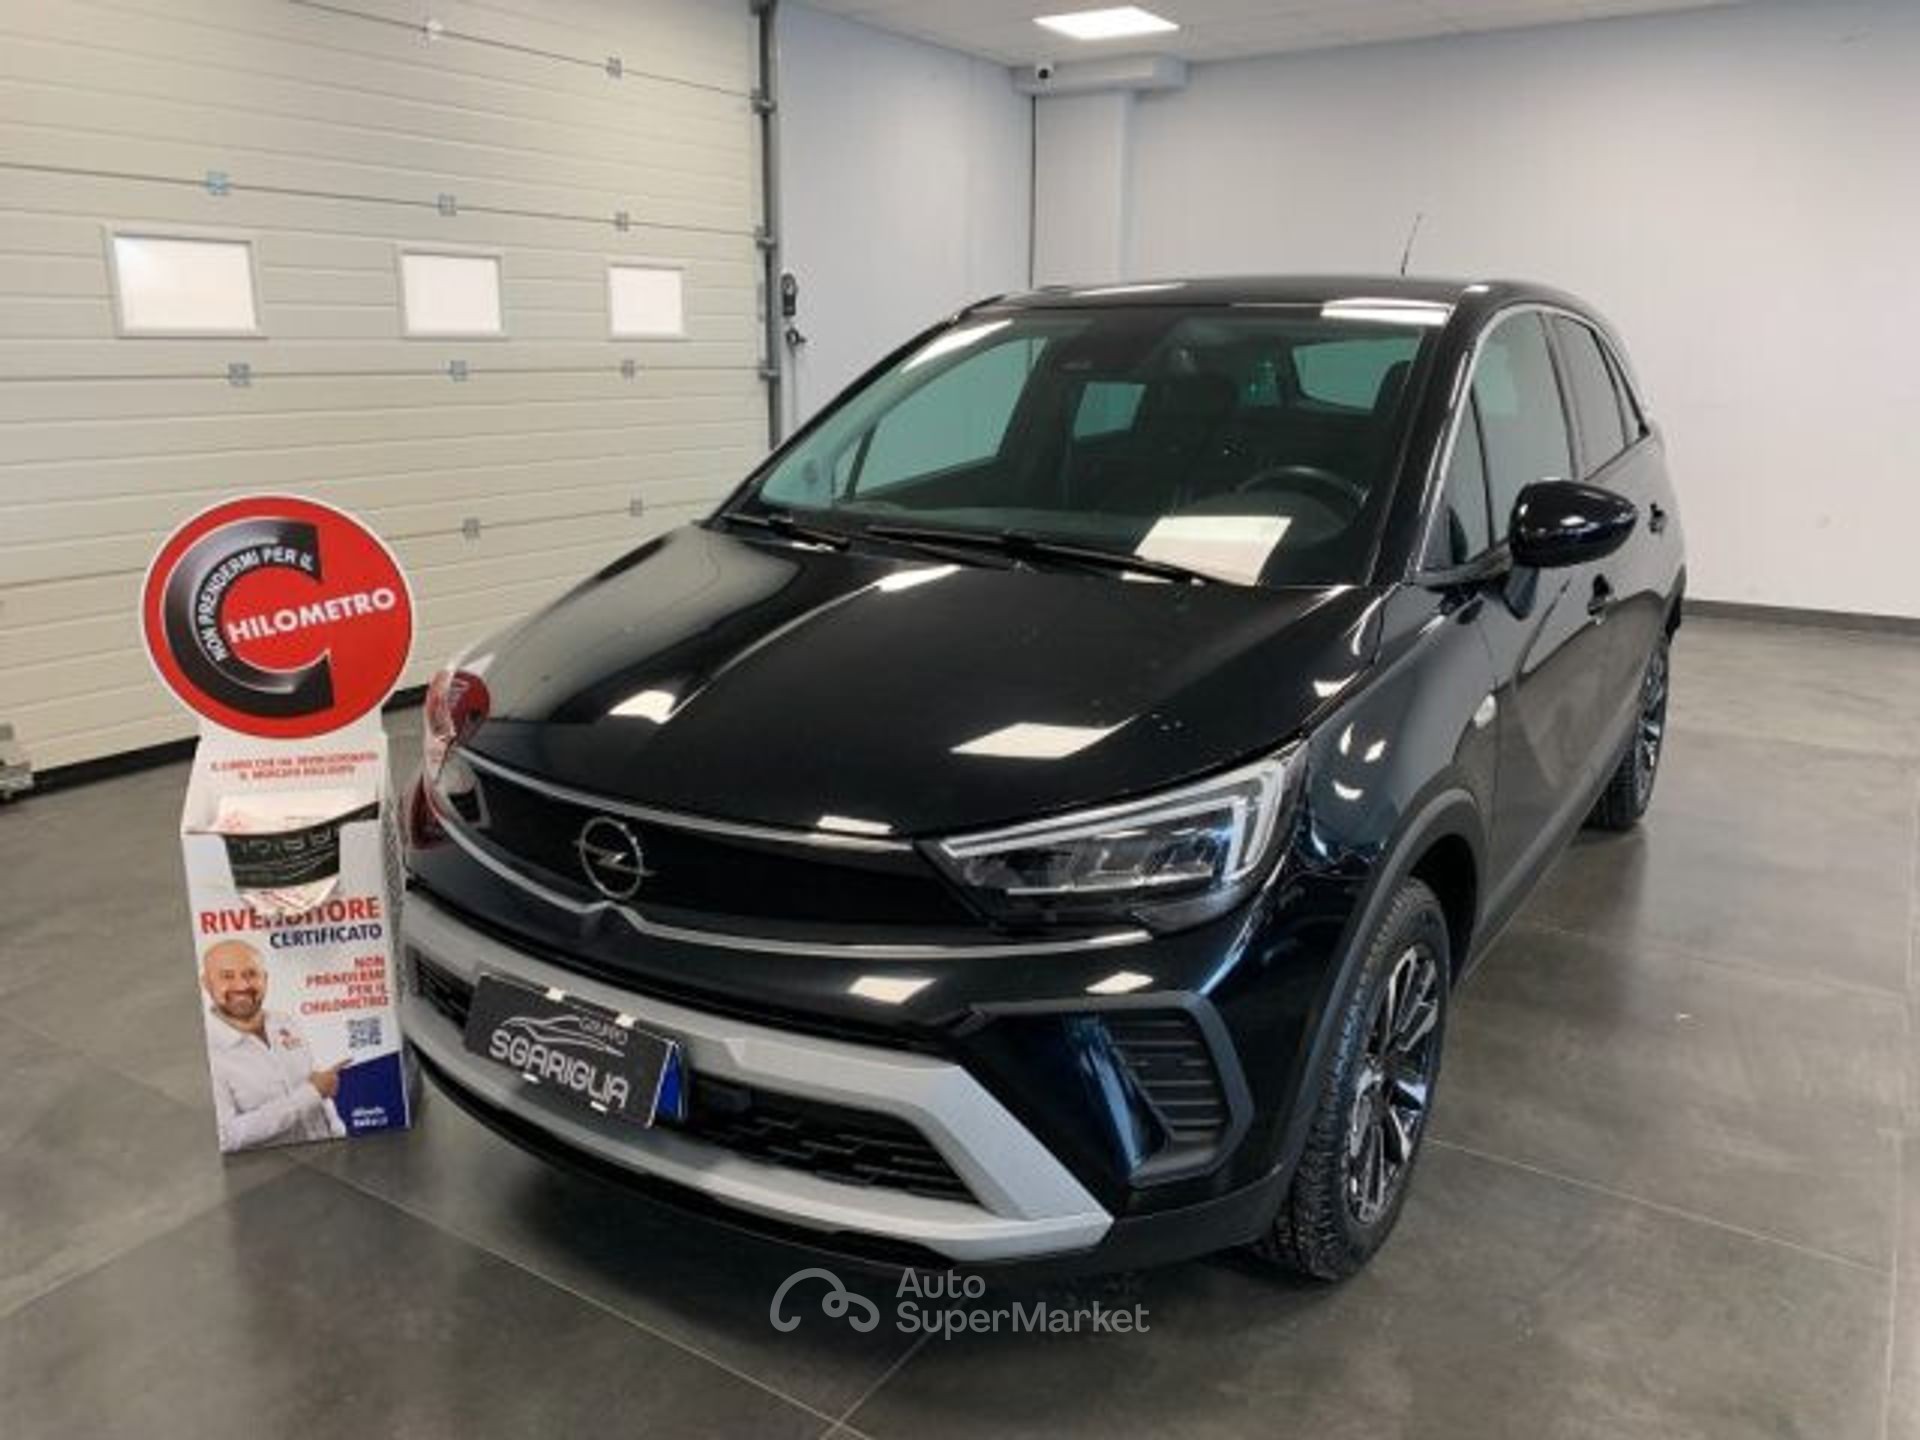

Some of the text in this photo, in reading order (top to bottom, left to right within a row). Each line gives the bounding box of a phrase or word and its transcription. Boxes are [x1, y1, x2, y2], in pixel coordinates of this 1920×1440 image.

[198, 546, 314, 661] NON PRENDERMI PER IL
[227, 587, 396, 643] HILOMETRO
[270, 923, 383, 949] CERTIFICATO
[489, 1029, 629, 1109] SGARIGLIA
